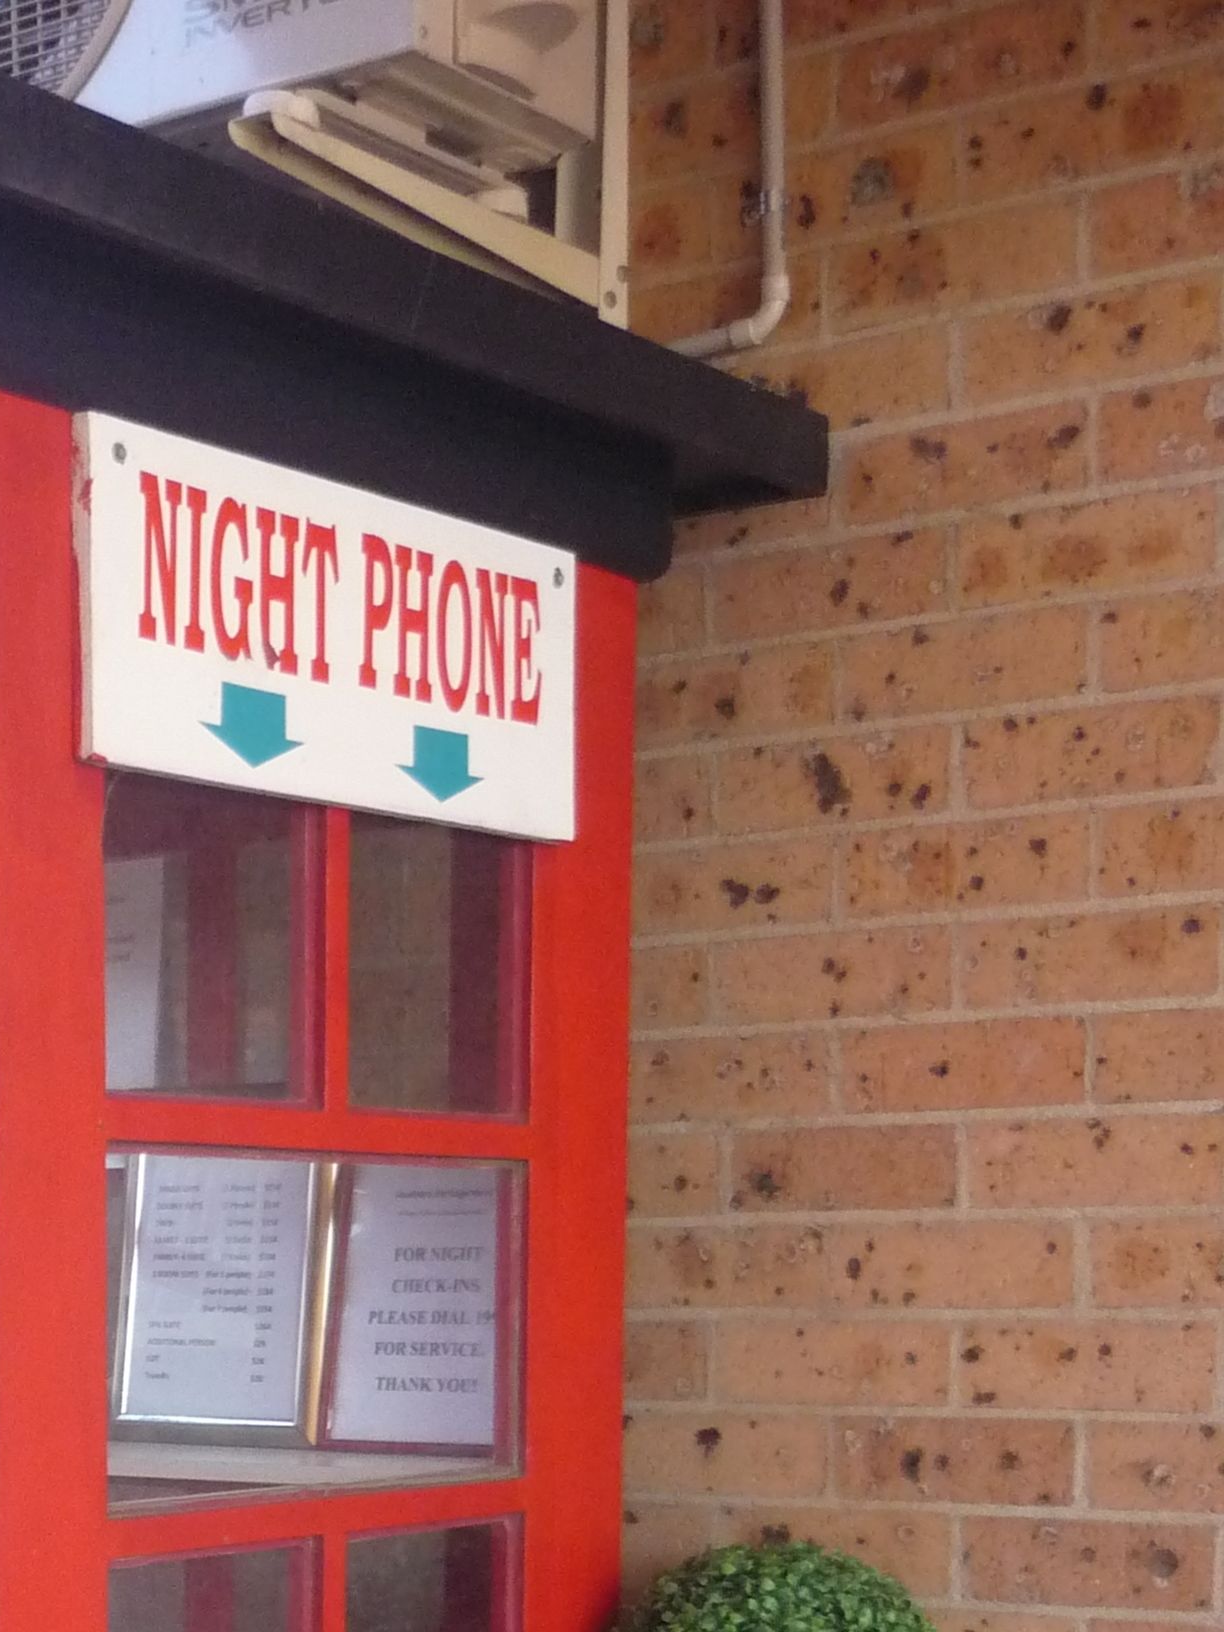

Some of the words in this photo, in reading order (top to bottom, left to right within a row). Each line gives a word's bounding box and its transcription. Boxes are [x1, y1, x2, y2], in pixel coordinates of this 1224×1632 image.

[138, 470, 339, 684] NIGHT
[358, 532, 542, 726] PHONE
[394, 1247, 426, 1262] FOR
[430, 1246, 485, 1262] NIGHT
[391, 1278, 482, 1294] CHECK-INS
[367, 1310, 427, 1326] PLEASE
[430, 1310, 471, 1326] DIAL
[374, 1341, 407, 1357] FOR
[375, 1376, 432, 1392] THANK
